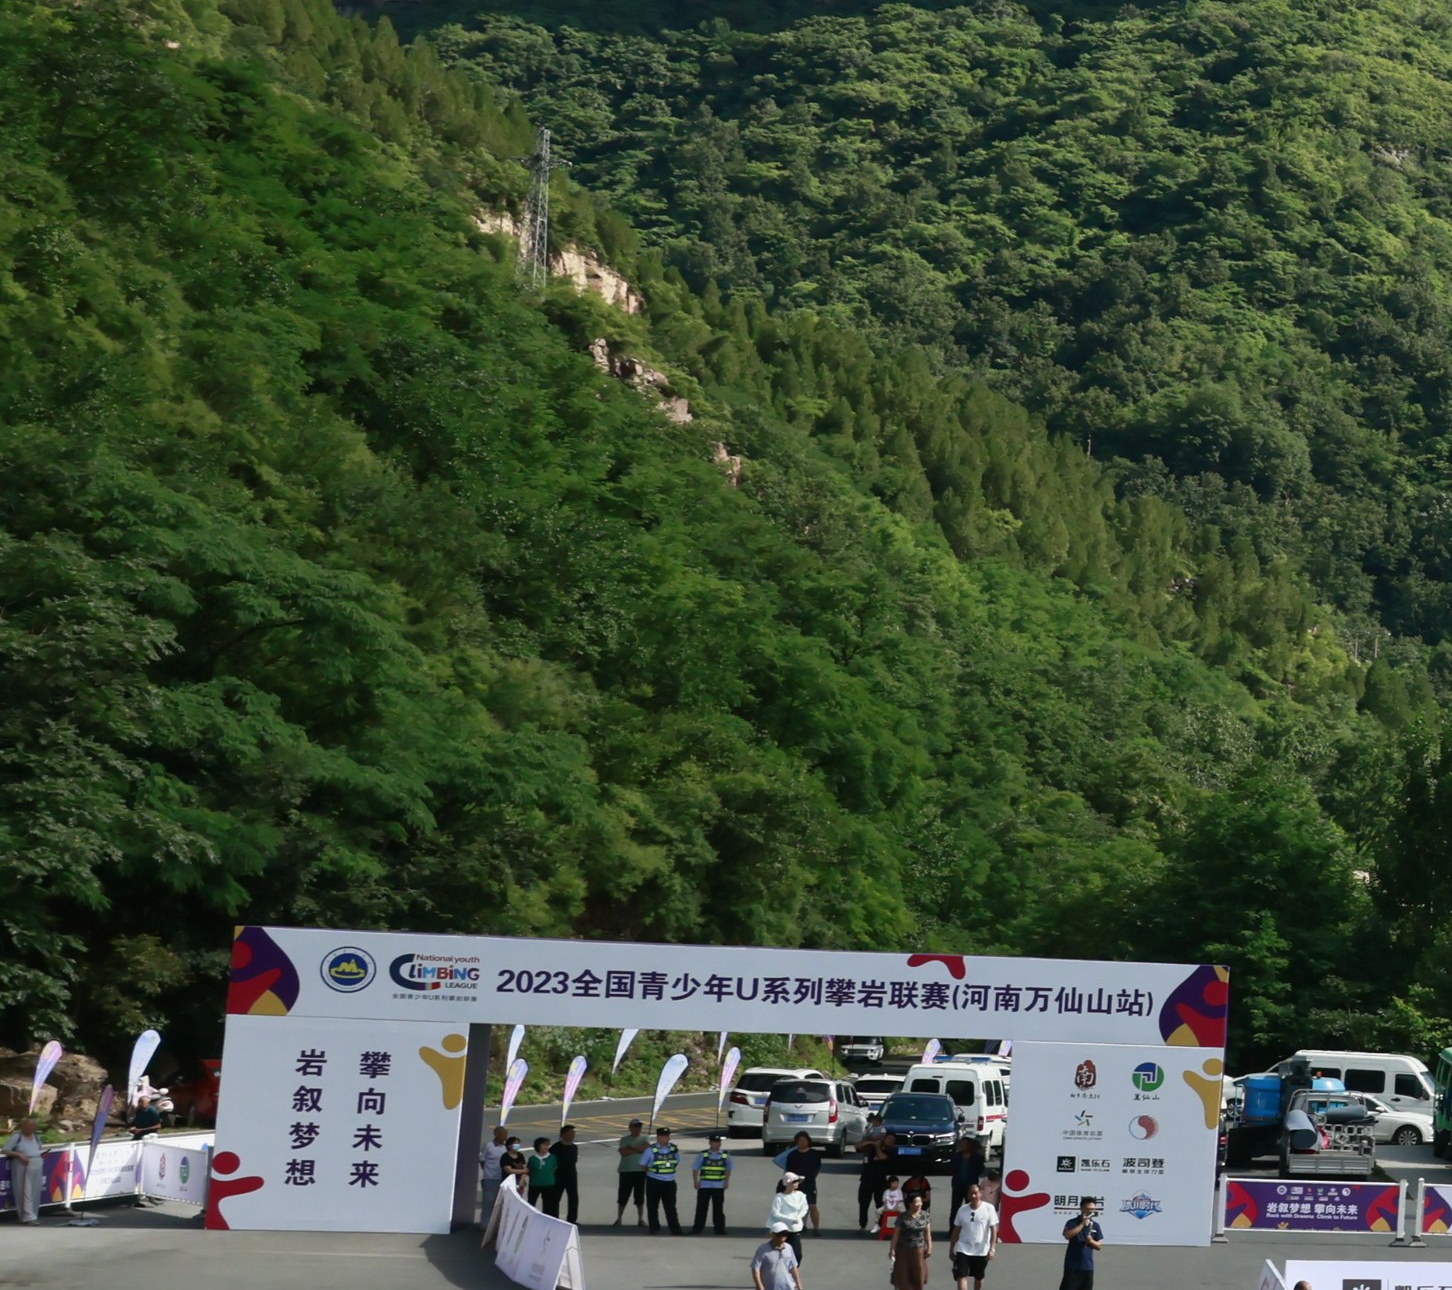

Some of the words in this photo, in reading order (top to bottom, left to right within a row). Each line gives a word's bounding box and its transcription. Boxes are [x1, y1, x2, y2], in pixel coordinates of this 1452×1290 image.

[416, 954, 453, 963] National
[453, 956, 480, 964] youth
[496, 968, 1155, 1019] 2023全国青少年U系列攀岩联赛(河南万仙山站)
[284, 1048, 327, 1188] 岩叙梦想
[349, 1050, 392, 1189] 攀向未来
[1054, 1195, 1104, 1207] 明月片
[1266, 1202, 1311, 1214] 岩叙梦想
[1314, 1204, 1359, 1215] 攀向未来
